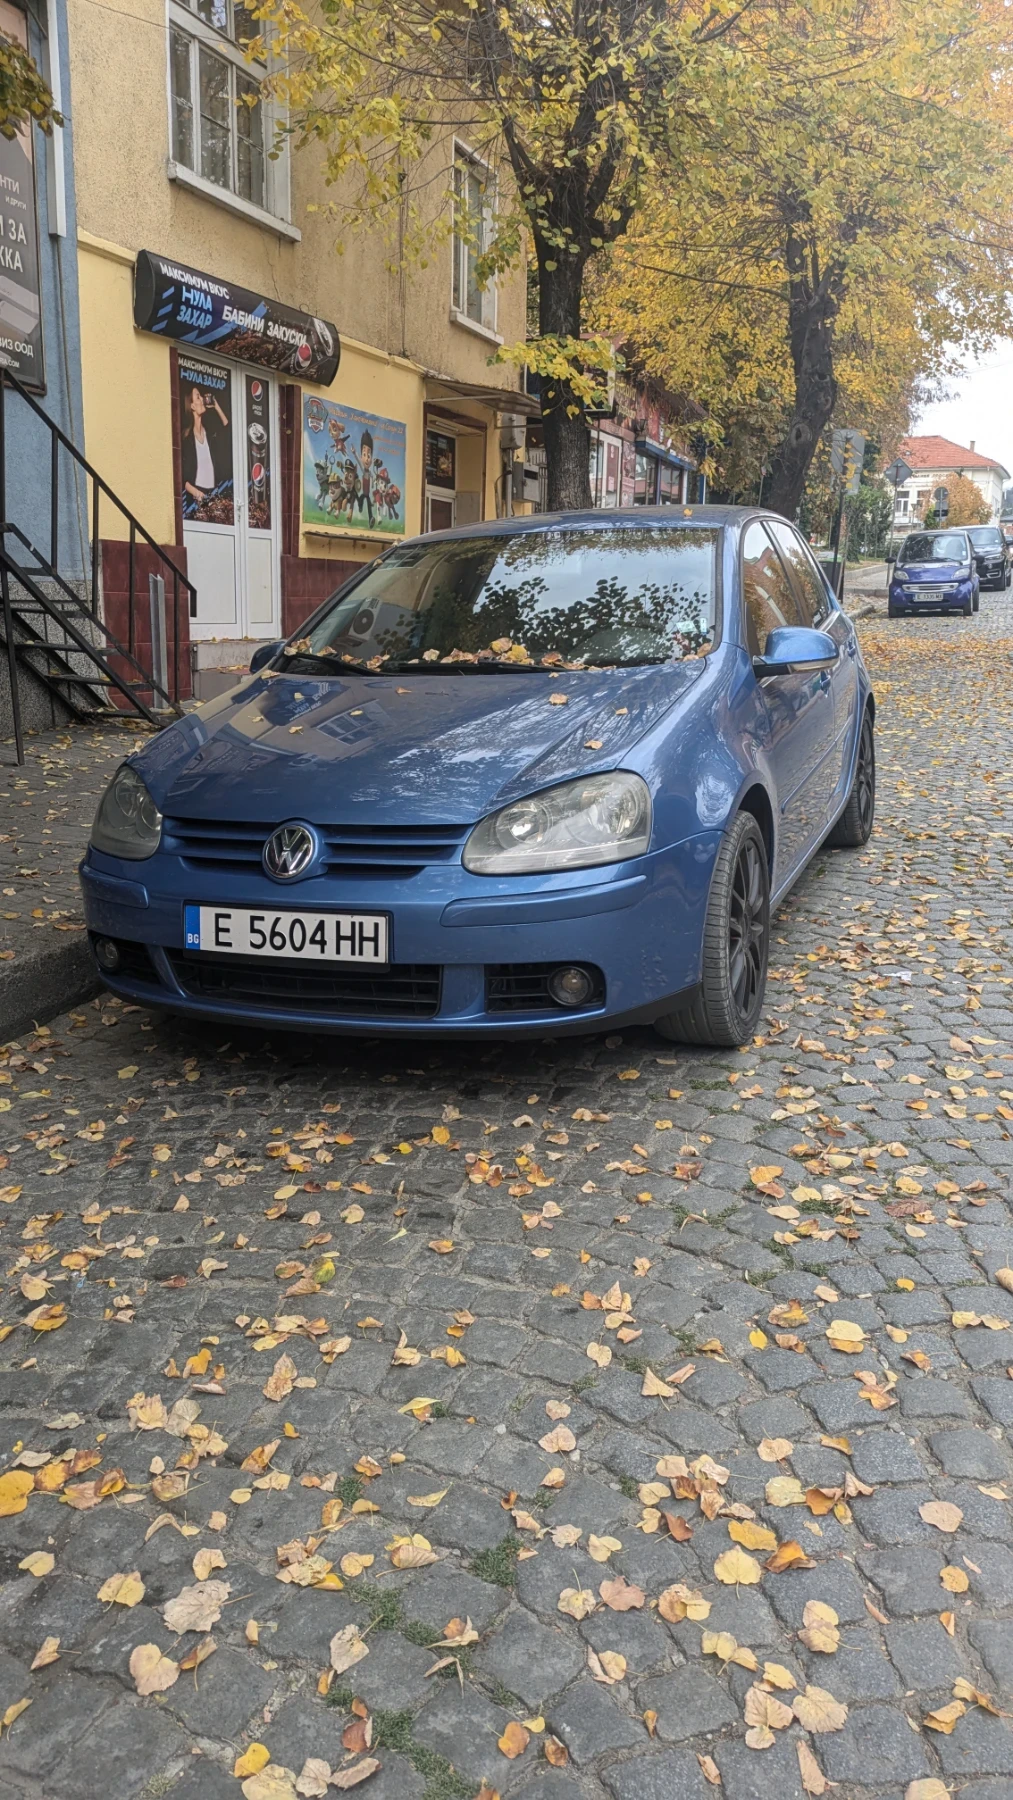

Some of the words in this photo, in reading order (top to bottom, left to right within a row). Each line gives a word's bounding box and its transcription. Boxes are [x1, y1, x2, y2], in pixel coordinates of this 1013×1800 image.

[8, 218, 27, 245] ЗА
[159, 262, 209, 292] МАКСИМУМ
[208, 281, 230, 300] ВКУС
[182, 285, 212, 311] НУЛА
[176, 305, 213, 329] ЗАХАР
[222, 305, 265, 333] БАБИНИ
[267, 321, 307, 347] ЗАКУСКИ
[14, 341, 34, 358] ООД
[178, 357, 213, 375] МАКСИМУМ
[213, 368, 228, 379] ВКУС
[180, 368, 203, 384] НУЛА
[203, 374, 226, 390] ЗАХАР
[187, 933, 199, 945] BG
[214, 912, 233, 948] E
[249, 915, 327, 954] 5604
[335, 920, 379, 957] HH
